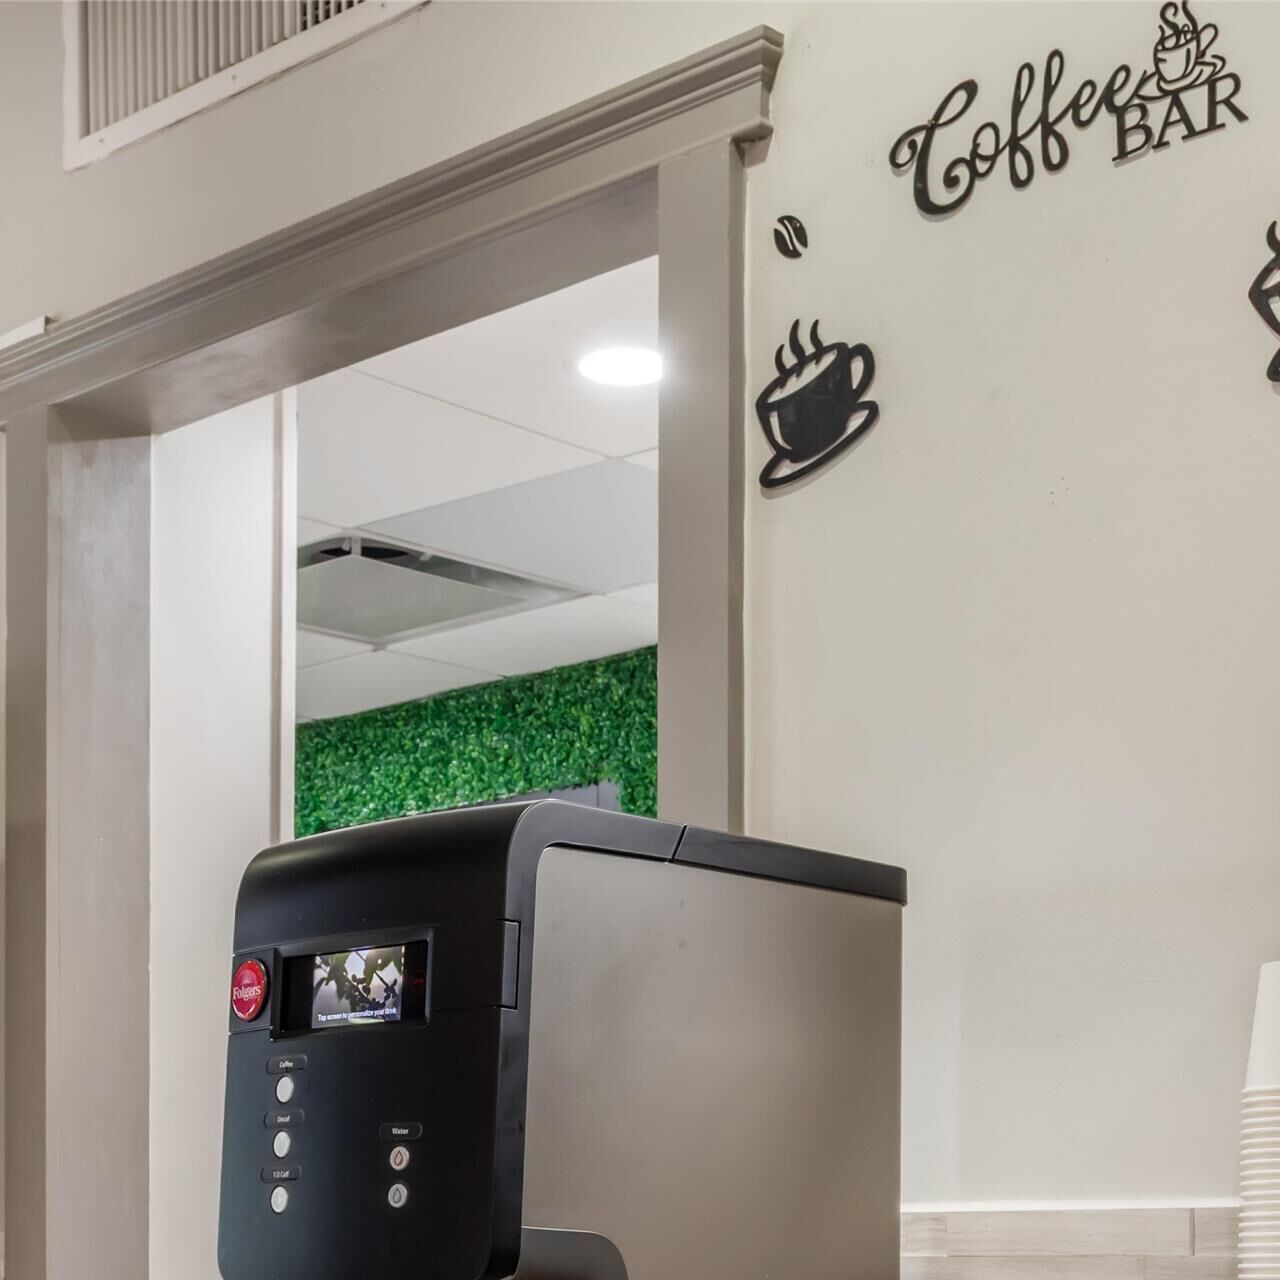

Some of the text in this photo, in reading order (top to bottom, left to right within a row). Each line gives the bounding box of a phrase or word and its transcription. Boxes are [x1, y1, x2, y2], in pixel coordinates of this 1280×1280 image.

[889, 48, 1155, 214] Coffee
[1112, 72, 1249, 162] BAR
[232, 985, 261, 1002] Folgers
